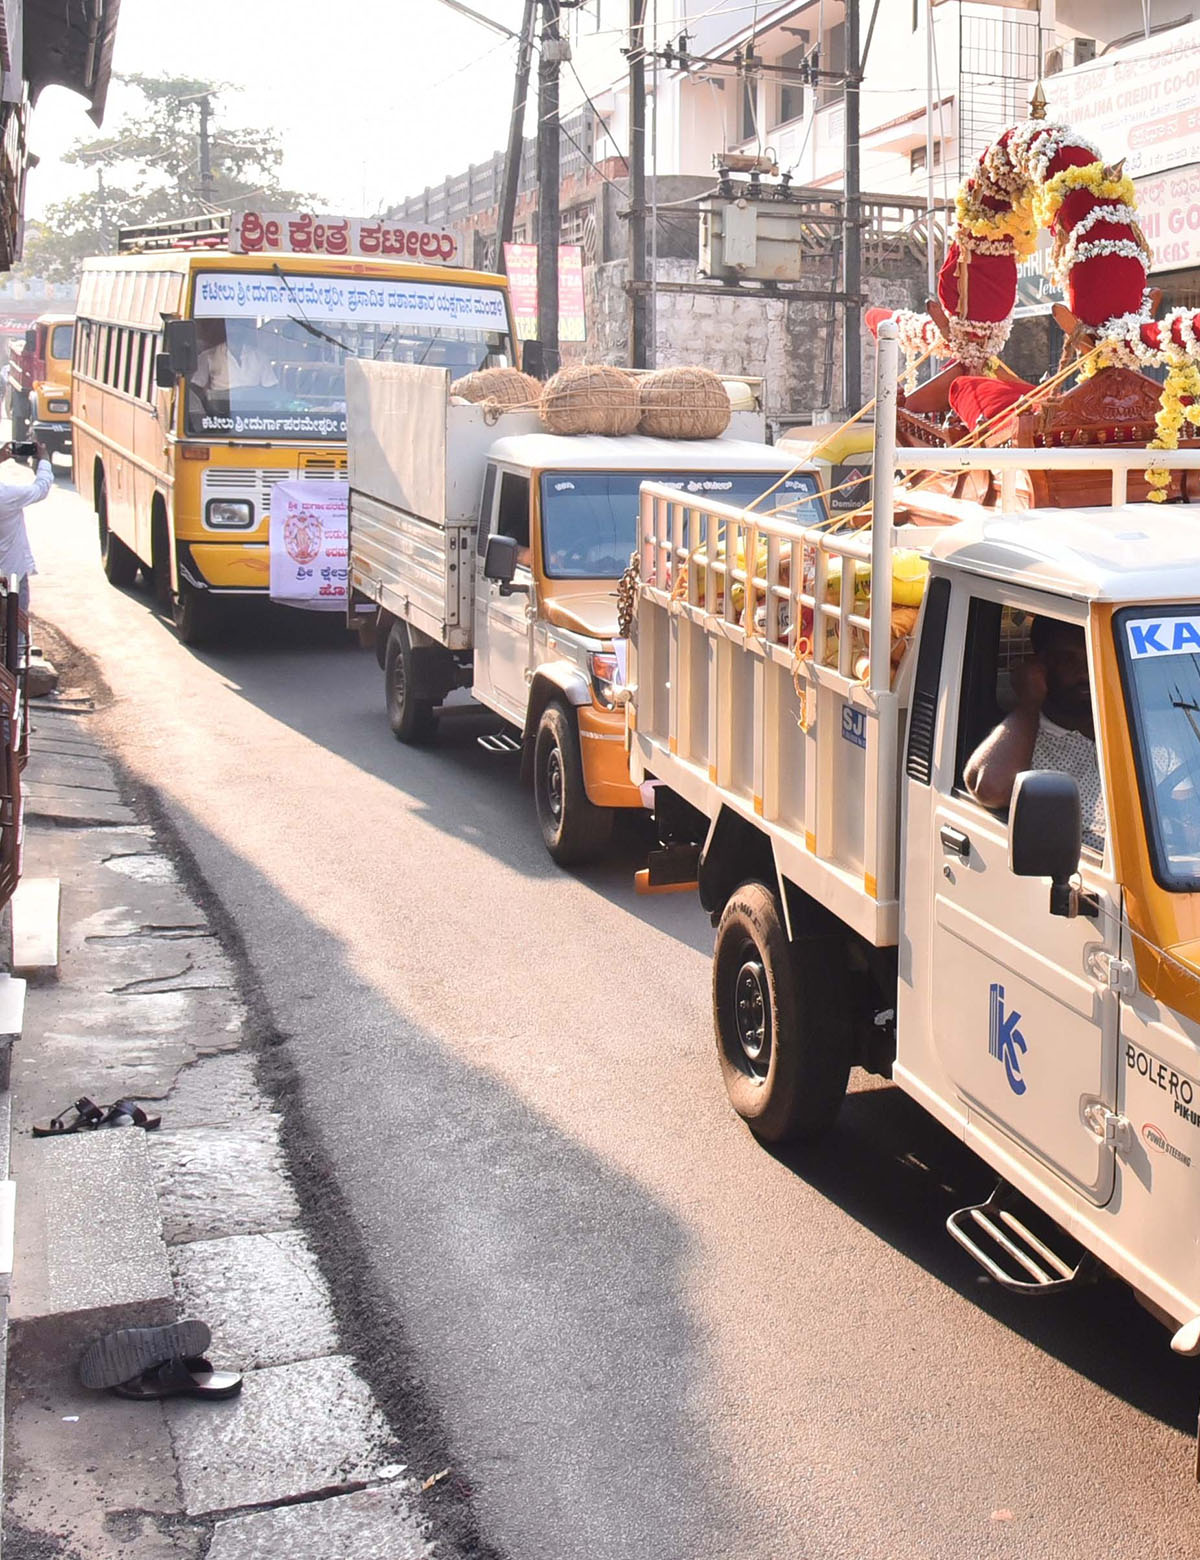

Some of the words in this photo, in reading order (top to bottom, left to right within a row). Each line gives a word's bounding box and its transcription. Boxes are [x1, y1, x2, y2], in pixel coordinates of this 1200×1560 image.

[1057, 98, 1114, 125] DAIWAJNA
[1117, 80, 1162, 111] CREDIT
[239, 212, 280, 251] ಶ್ರೀ
[288, 213, 350, 253] ಕ್ಷೇತ್ರ
[358, 226, 457, 262] ಕಟೀಲು
[202, 280, 236, 301] ಕಟೀಲು
[388, 290, 435, 311] ದಶಾವತಾರ
[202, 415, 234, 430] ಕಟೀಲು
[295, 566, 314, 581] ಶ್ರೀ
[1126, 1044, 1194, 1105] BOLERO
[1146, 1129, 1166, 1150] POWER
[1165, 1142, 1192, 1168] STEERING
